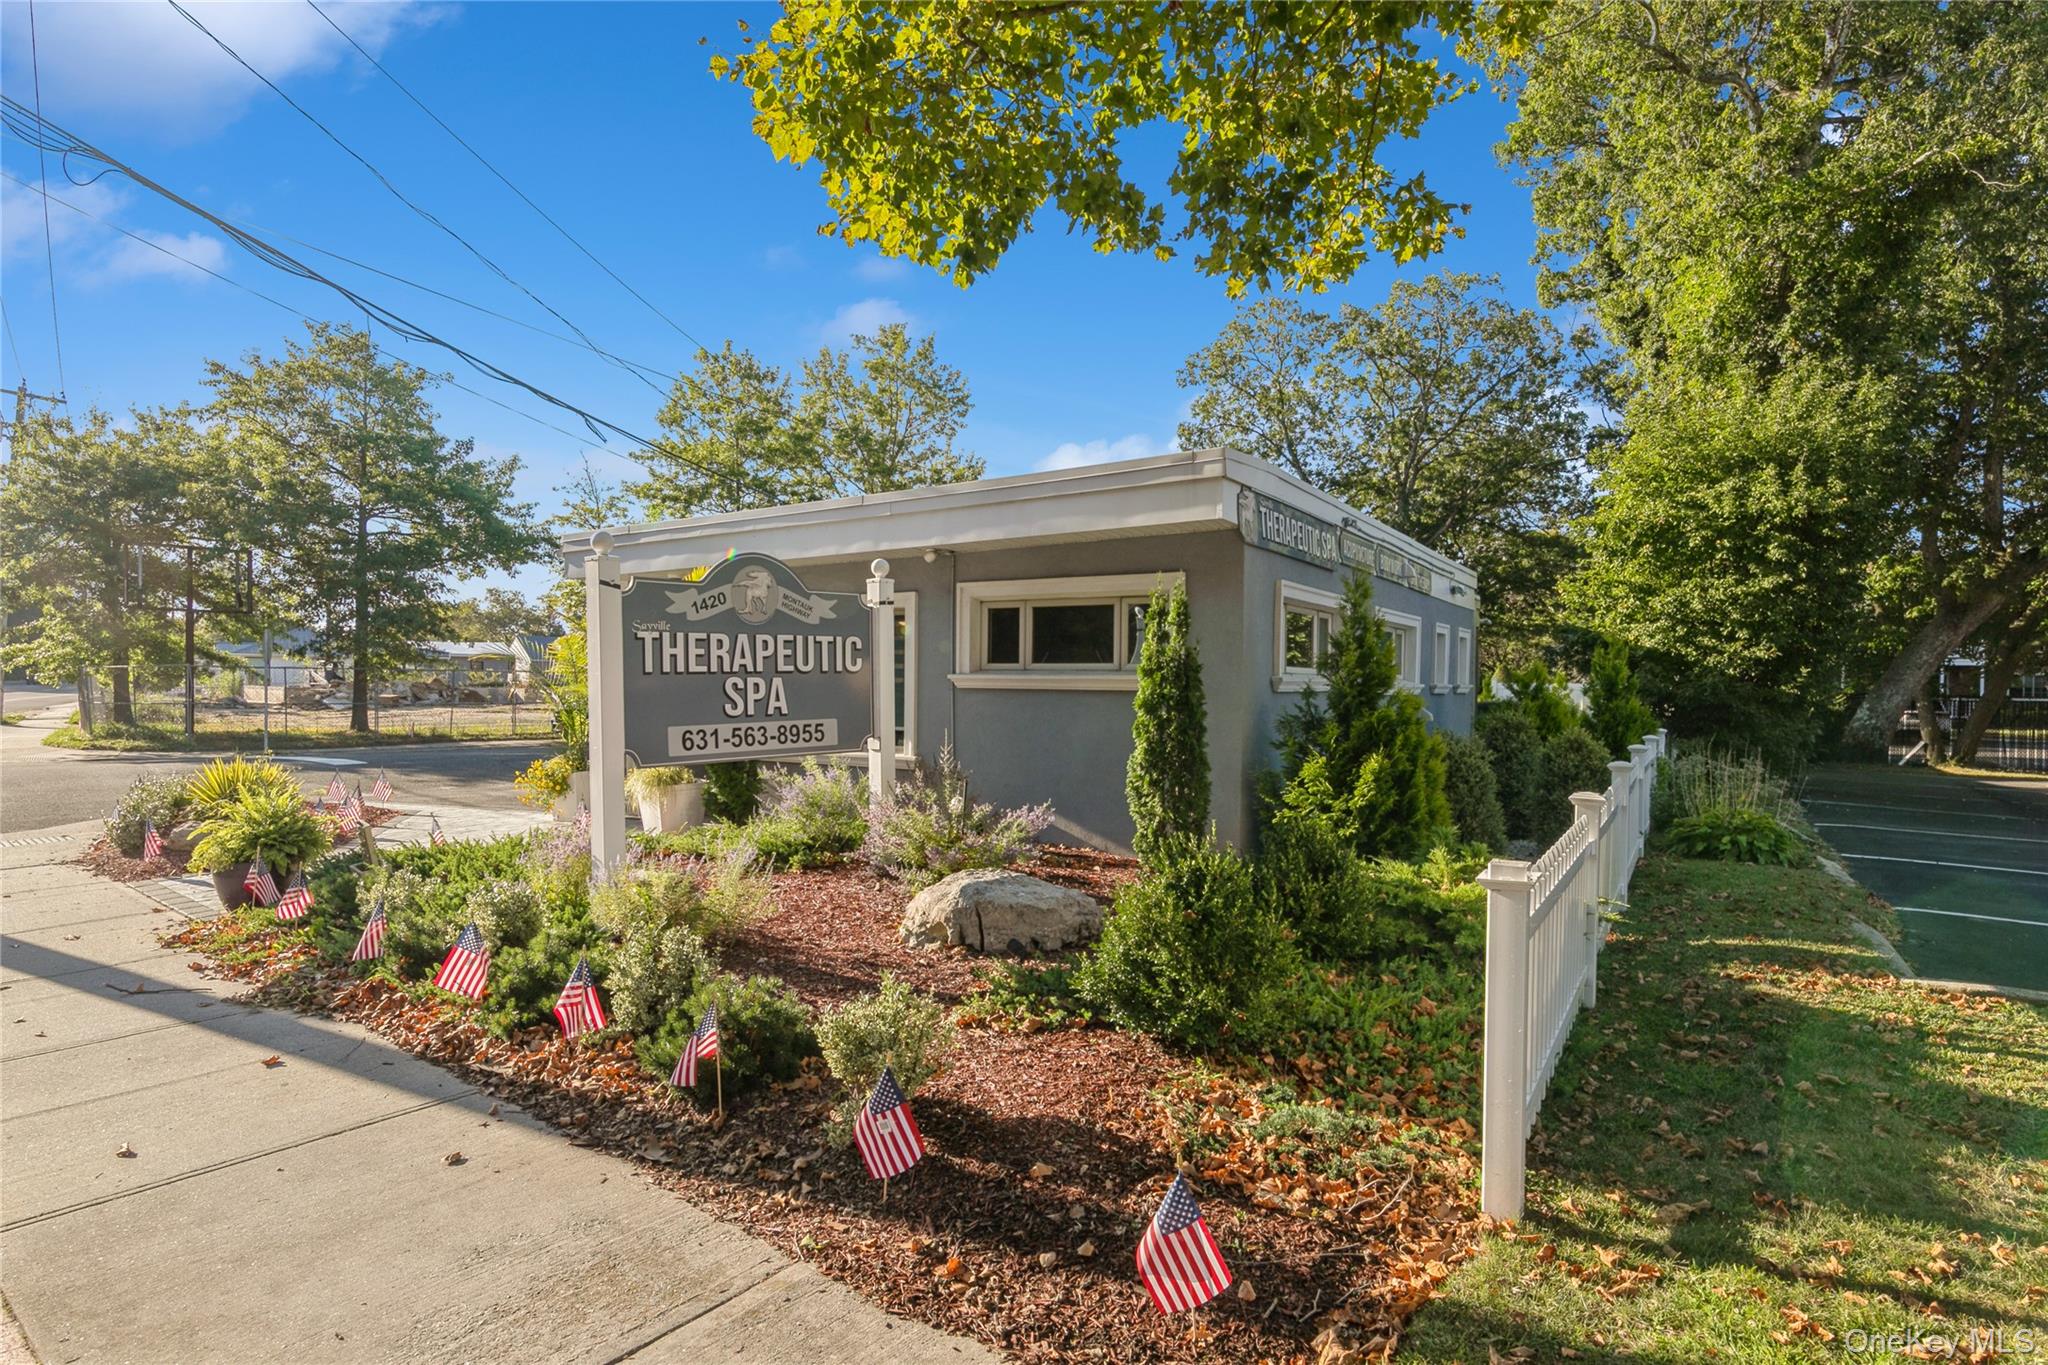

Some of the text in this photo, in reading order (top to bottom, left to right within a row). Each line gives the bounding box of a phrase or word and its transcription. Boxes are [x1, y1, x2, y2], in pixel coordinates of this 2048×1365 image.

[1260, 506, 1338, 563] THERAPEUTIC SPA
[691, 592, 727, 615] 1420
[781, 601, 811, 619] HIGHWAY
[782, 593, 814, 613] MONTAUK
[632, 619, 671, 634] Sayville
[636, 631, 863, 674] THERAPEUTIC
[723, 676, 789, 718] SPA
[681, 722, 825, 751] 631-563-8955
